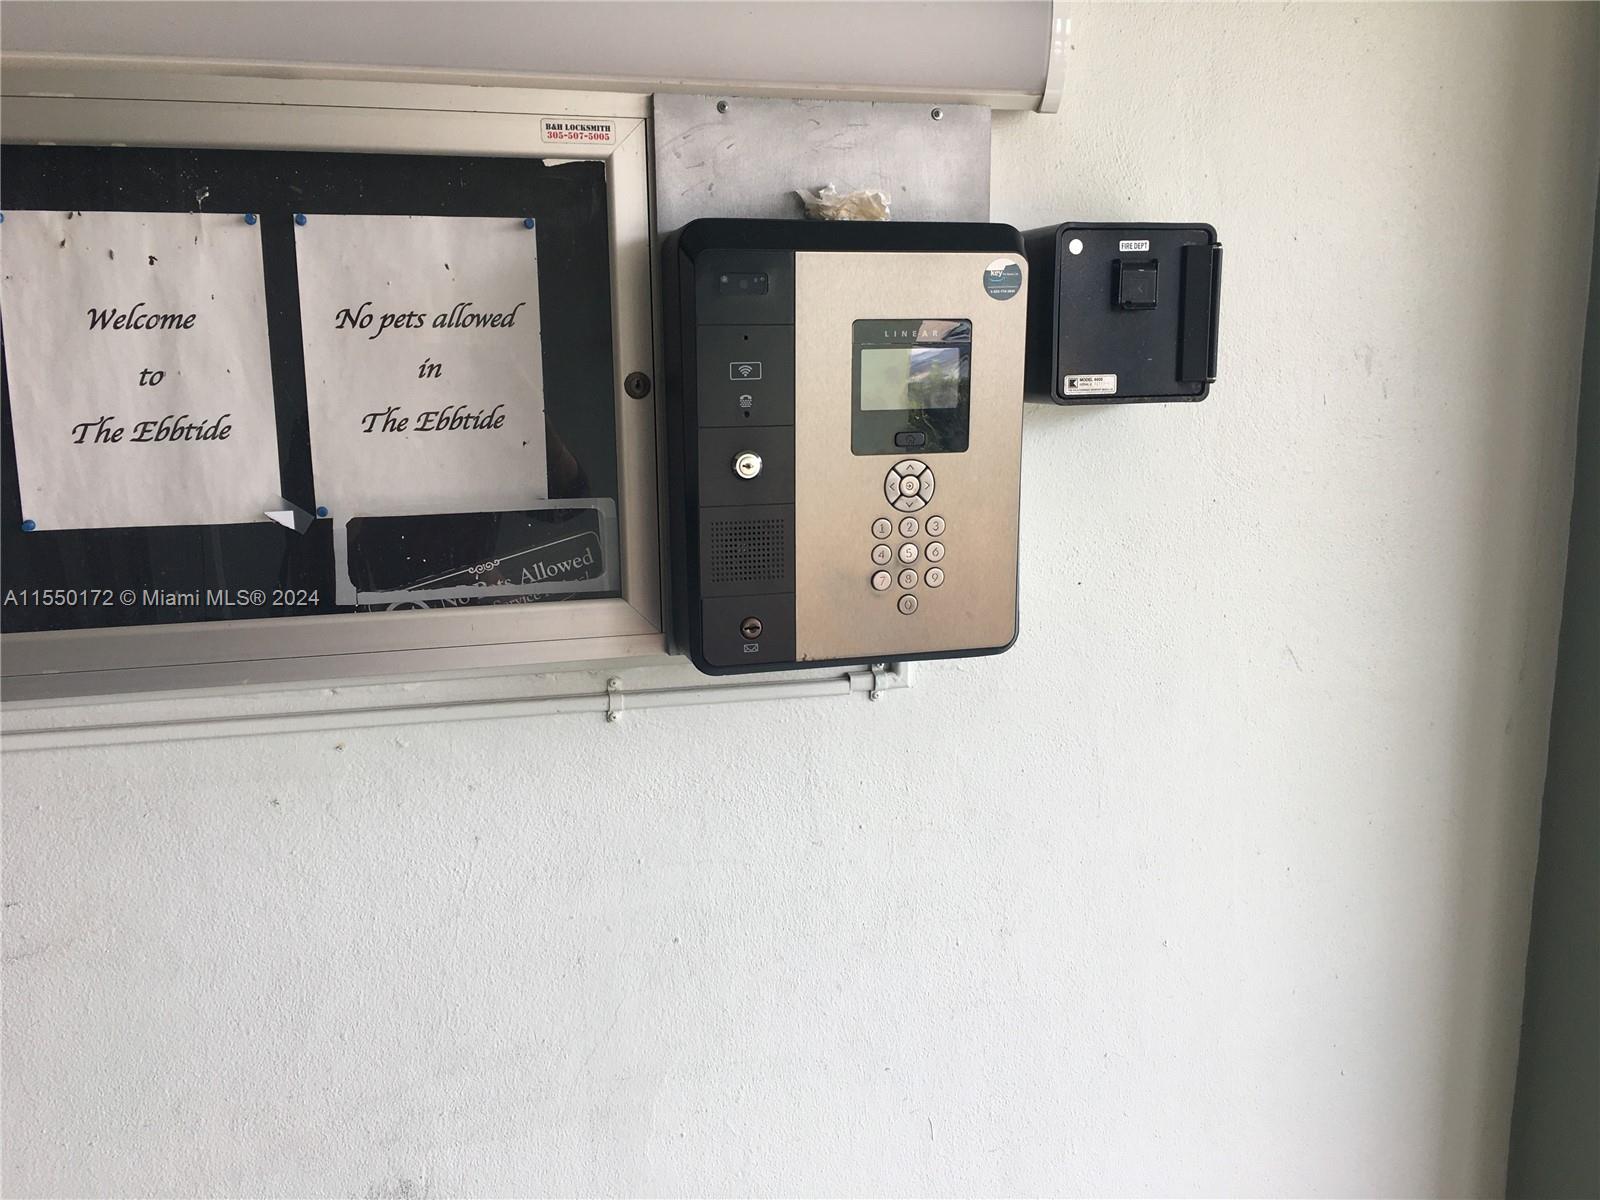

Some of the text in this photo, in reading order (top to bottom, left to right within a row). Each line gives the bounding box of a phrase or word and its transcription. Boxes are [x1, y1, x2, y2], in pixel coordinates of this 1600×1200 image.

[545, 123, 611, 132] B&H LOCKSMITH
[547, 131, 610, 141] 305-507-5005
[1121, 241, 1148, 250] FIRE DEPT
[87, 302, 197, 330] Welcome
[335, 301, 526, 340] No pets allowed
[884, 329, 939, 338] LINEAR
[139, 367, 164, 387] to
[418, 357, 443, 379] in
[71, 413, 232, 444] The Ebbtide
[361, 403, 506, 433] The Ebbtide
[520, 547, 595, 585] Allowed
